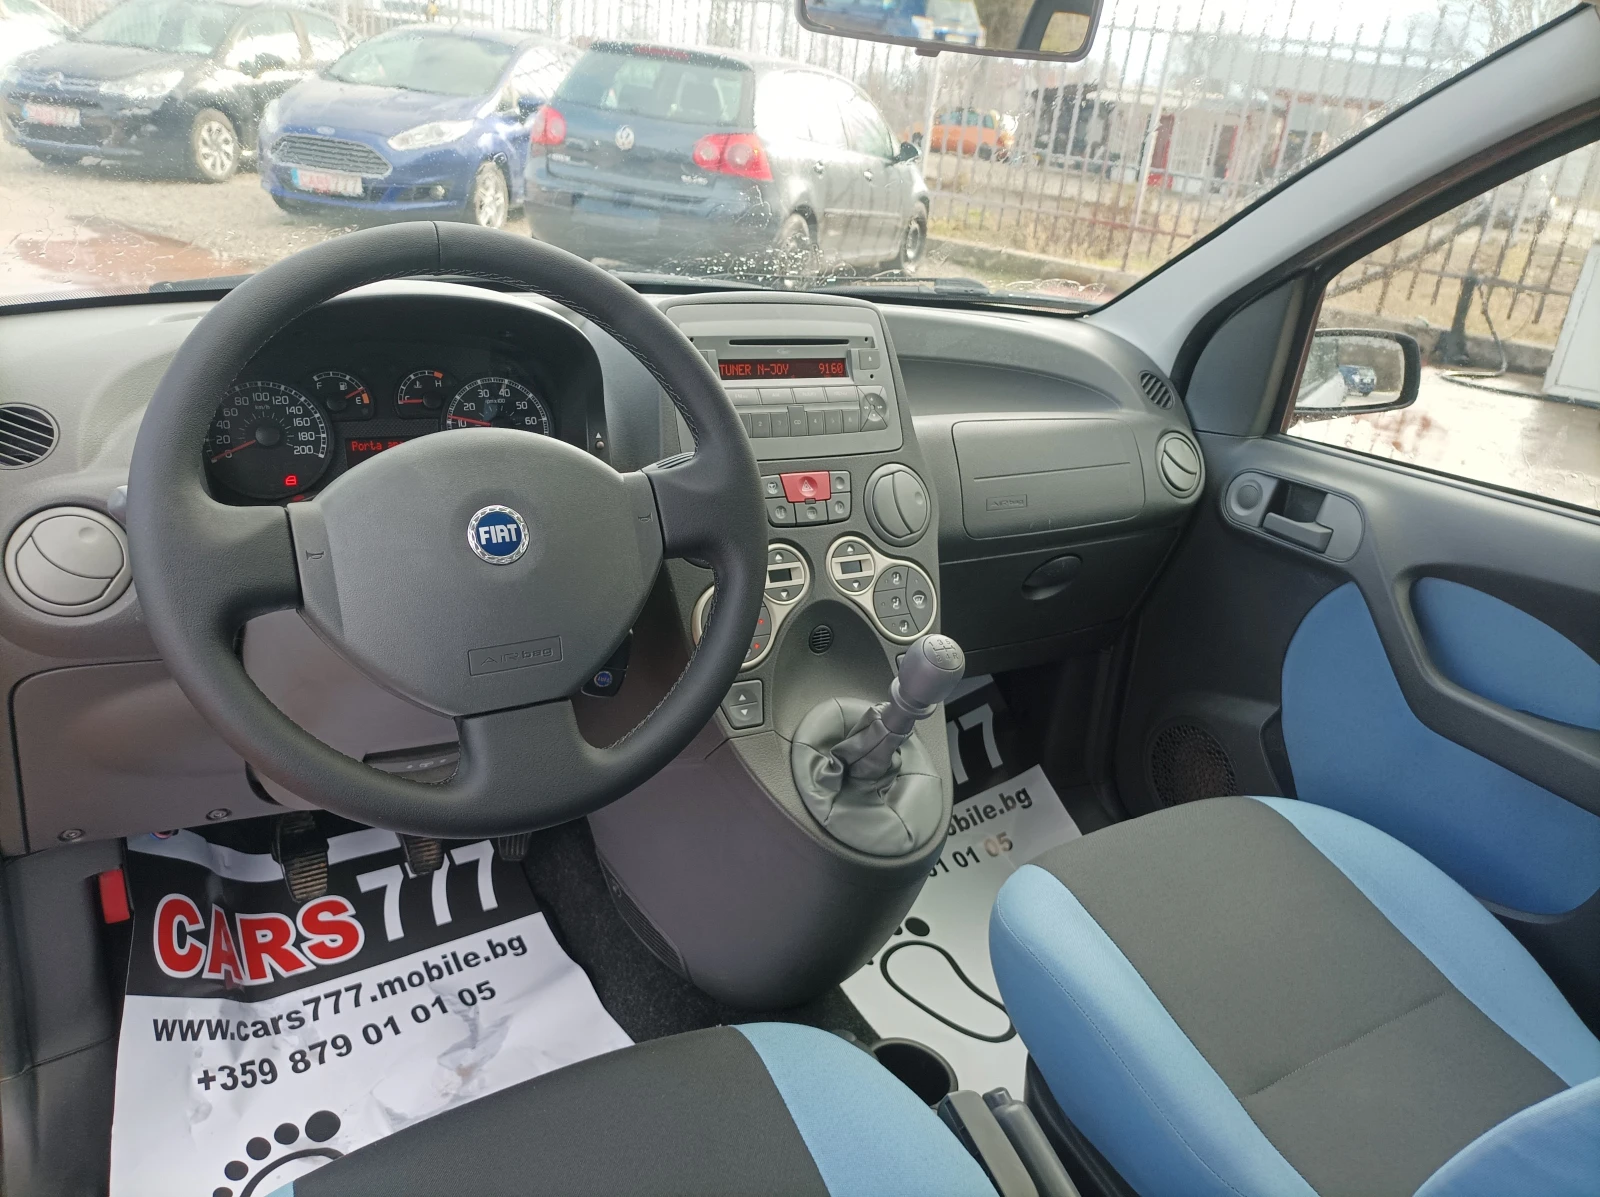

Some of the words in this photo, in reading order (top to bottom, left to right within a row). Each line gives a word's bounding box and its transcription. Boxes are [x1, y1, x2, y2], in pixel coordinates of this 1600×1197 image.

[718, 363, 752, 376] TUNER
[757, 363, 789, 375] N-JOY
[316, 381, 323, 390] F
[435, 380, 442, 388] H
[252, 392, 270, 402] 100
[477, 389, 489, 398] 30
[498, 388, 511, 397] 40
[234, 396, 249, 406] 80
[271, 395, 289, 405] 120
[355, 396, 362, 405] E
[285, 406, 303, 415] 140
[463, 402, 476, 411] 20
[515, 401, 528, 410] 50
[223, 407, 238, 417] 60
[216, 420, 231, 430] 40
[293, 417, 311, 427] 160
[524, 416, 537, 426] 60
[216, 435, 231, 445] 20
[298, 431, 315, 441] 180
[293, 445, 314, 455] 200
[351, 440, 383, 452] Porta
[478, 523, 518, 545] FIAT
[952, 846, 981, 868] 01
[983, 831, 1013, 858] 05
[152, 931, 528, 1042] www.cars777.mobile.bg
[197, 1055, 279, 1092] +359
[289, 1034, 354, 1073] 879
[362, 1016, 403, 1046] 01
[411, 996, 450, 1024] 01
[454, 980, 497, 1008] 05
